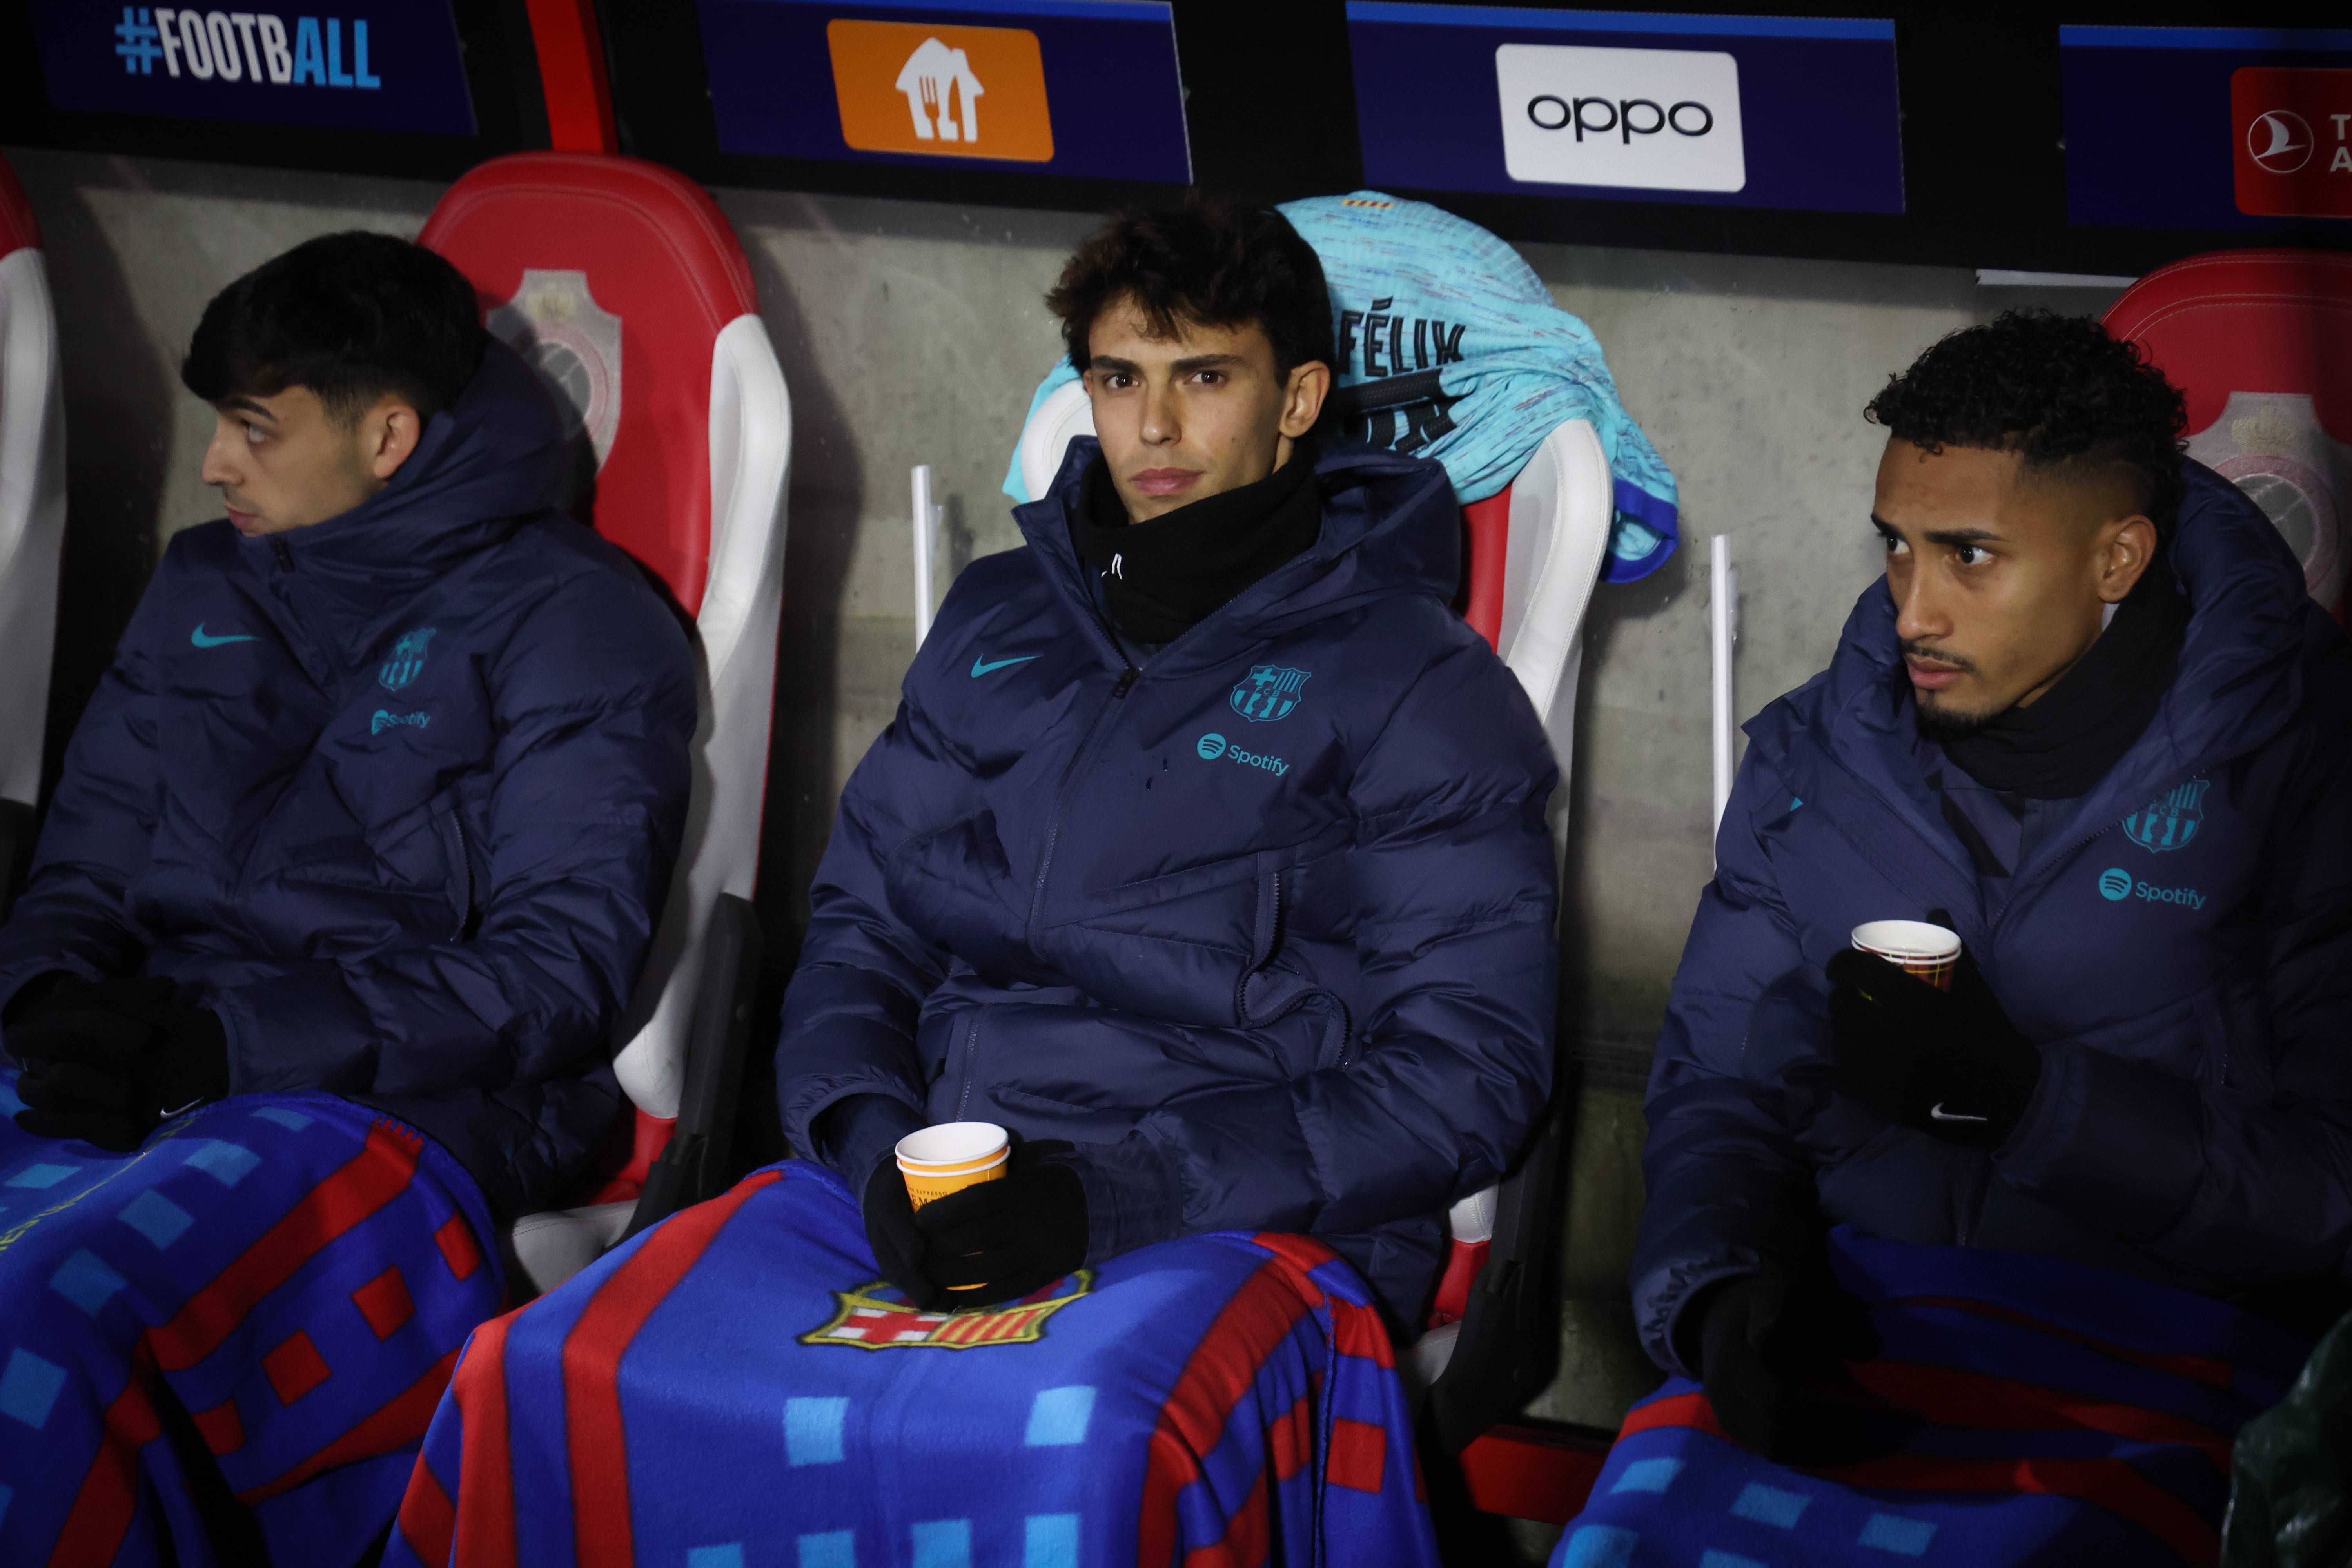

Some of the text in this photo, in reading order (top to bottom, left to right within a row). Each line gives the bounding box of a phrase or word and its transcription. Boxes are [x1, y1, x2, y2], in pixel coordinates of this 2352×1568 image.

[115, 6, 381, 89] #FOOTBALL
[1528, 94, 1713, 145] oppo
[1338, 296, 1466, 377] FÉLIX
[1228, 745, 1290, 776] Spotify
[2136, 881, 2206, 910] Spotify
